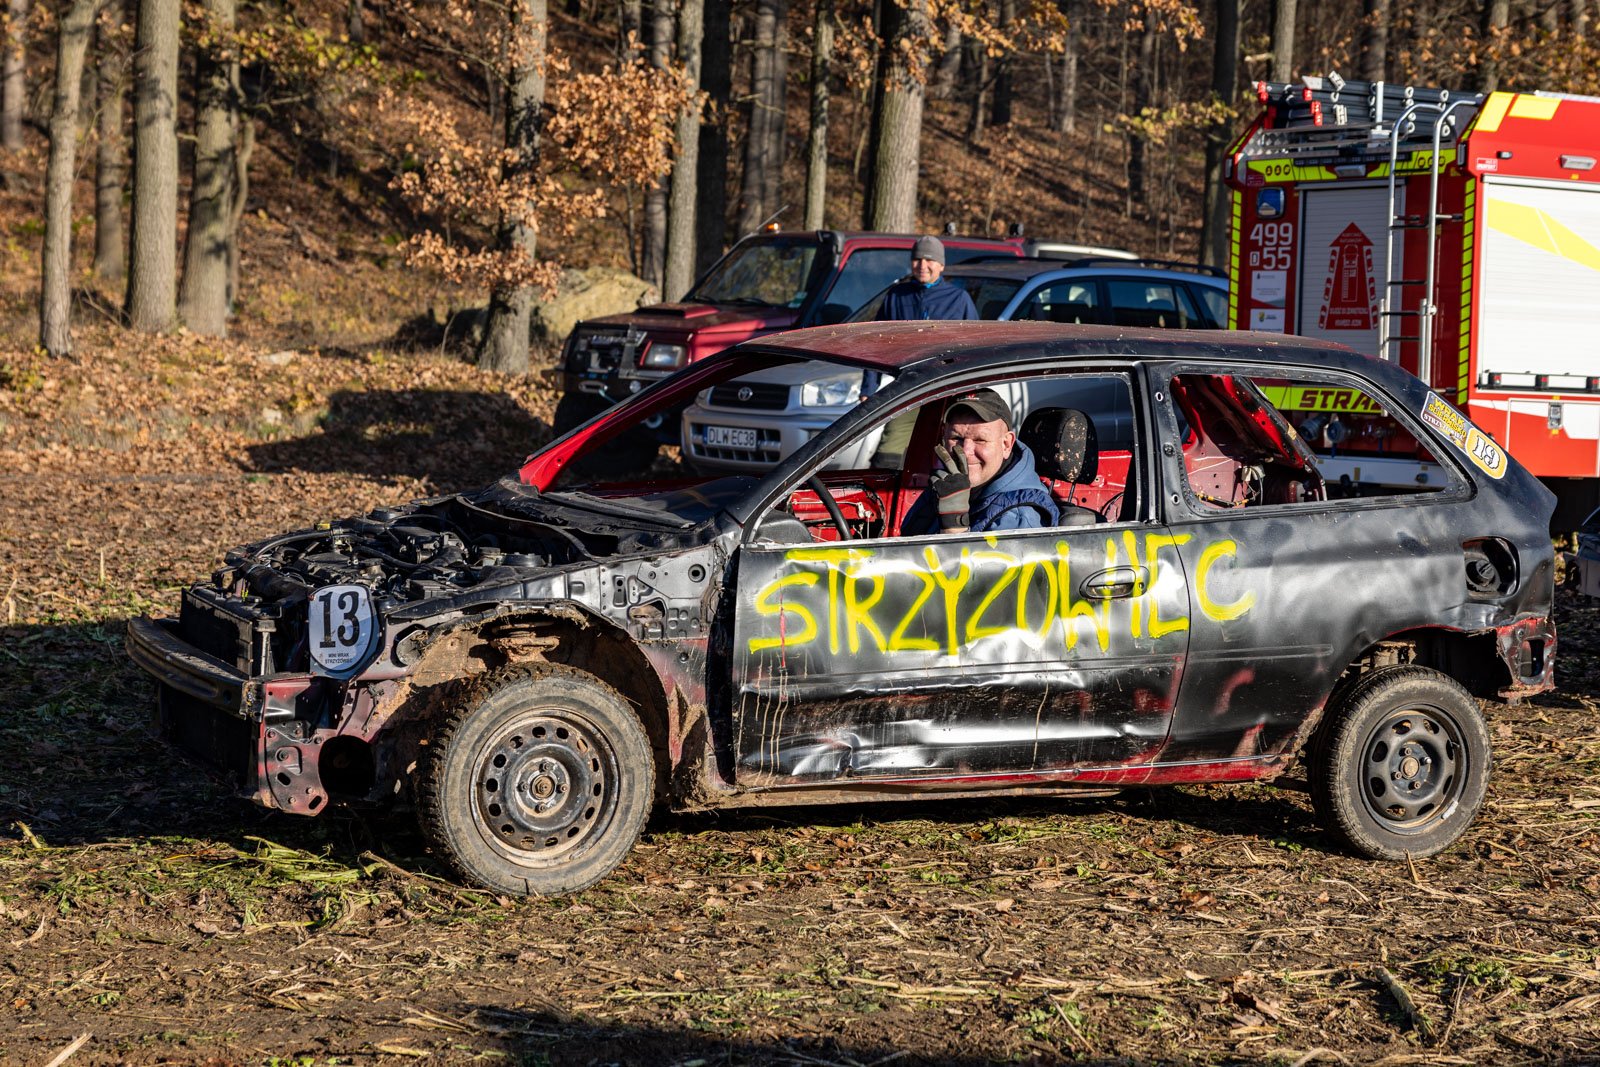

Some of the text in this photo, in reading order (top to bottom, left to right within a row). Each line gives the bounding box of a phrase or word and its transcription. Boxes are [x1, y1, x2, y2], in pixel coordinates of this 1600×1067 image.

[1250, 223, 1293, 247] 499
[1262, 247, 1291, 270] 55
[708, 428, 729, 444] DLW
[1472, 434, 1501, 470] 19
[318, 591, 360, 648] 13
